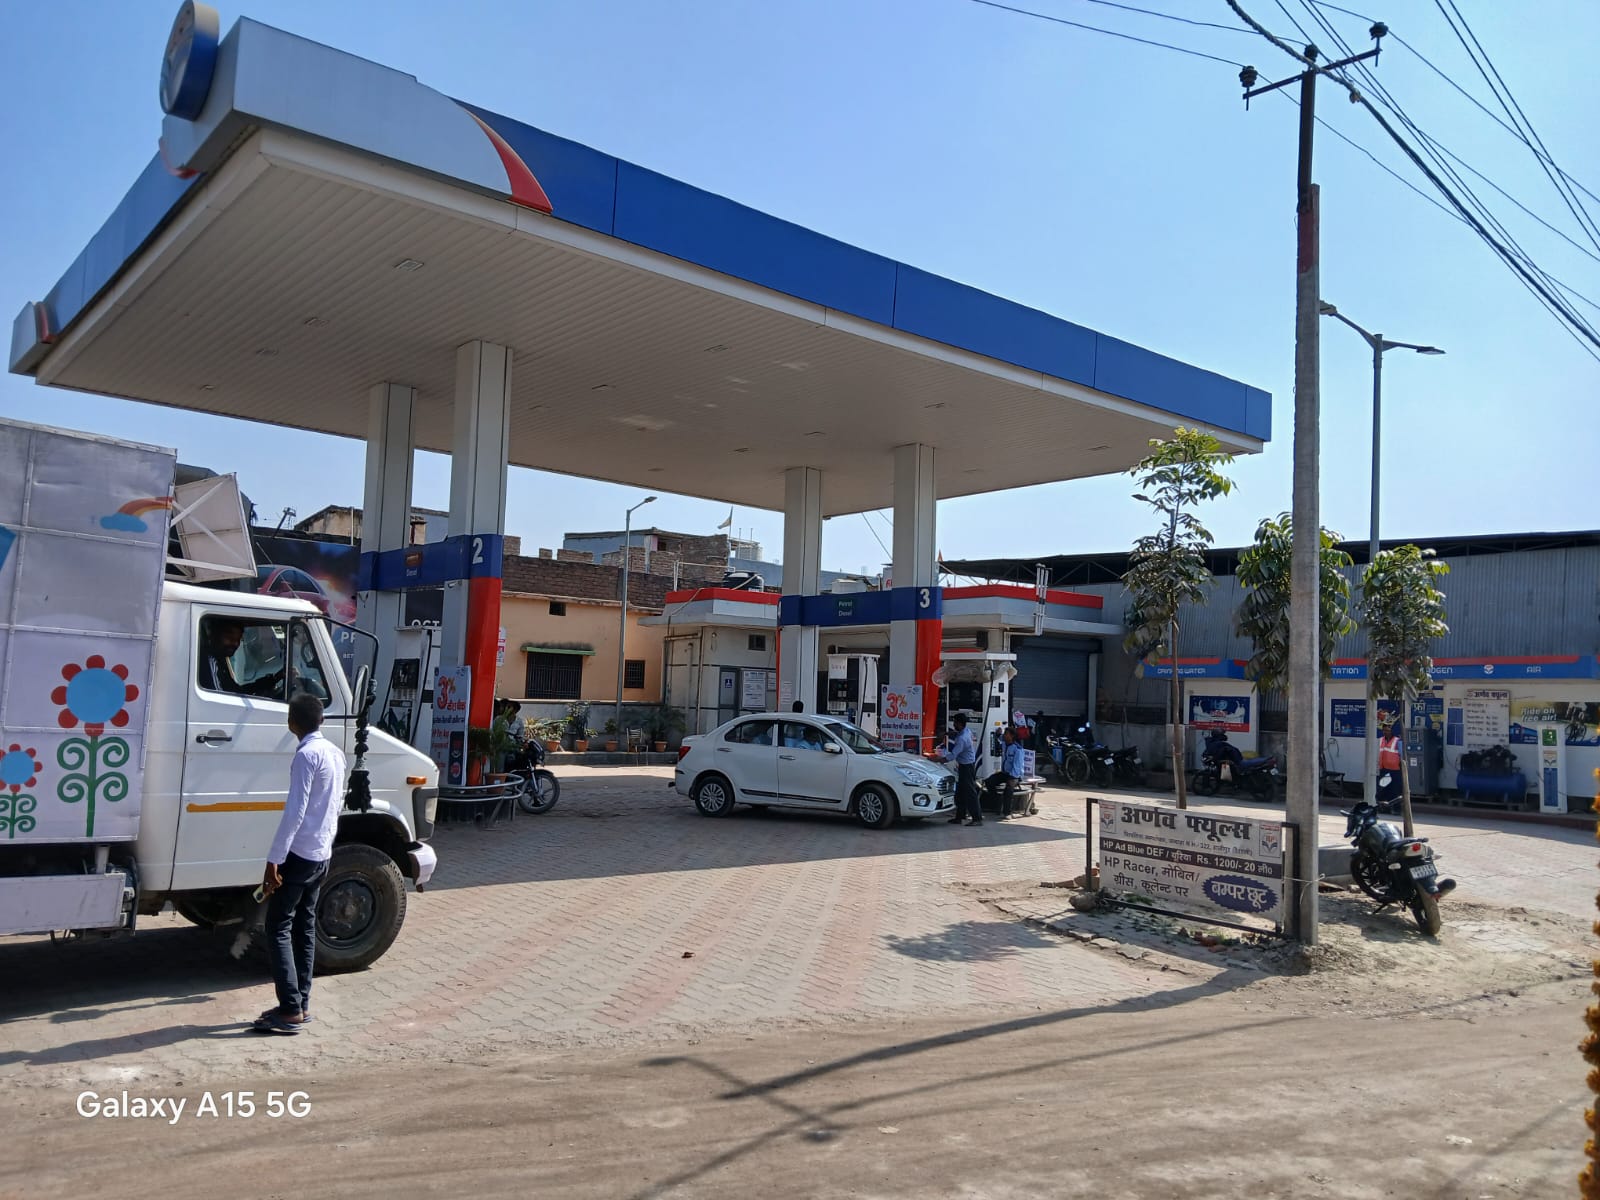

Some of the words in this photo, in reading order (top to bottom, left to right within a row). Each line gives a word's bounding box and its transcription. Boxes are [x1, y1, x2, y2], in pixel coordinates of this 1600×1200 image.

[472, 537, 484, 565] 2
[919, 588, 930, 609] 3
[1331, 667, 1359, 675] TATION
[1121, 806, 1177, 829] अर्णव
[1103, 840, 1113, 849] HP
[1115, 842, 1126, 851] Ad
[1127, 844, 1145, 855] Blue
[1146, 846, 1164, 857] DEF
[1244, 862, 1256, 872] 20
[1104, 855, 1120, 867] HP
[1174, 885, 1189, 897] पर
[1211, 881, 1246, 900] बम्पर
[1246, 886, 1268, 909] छूट
